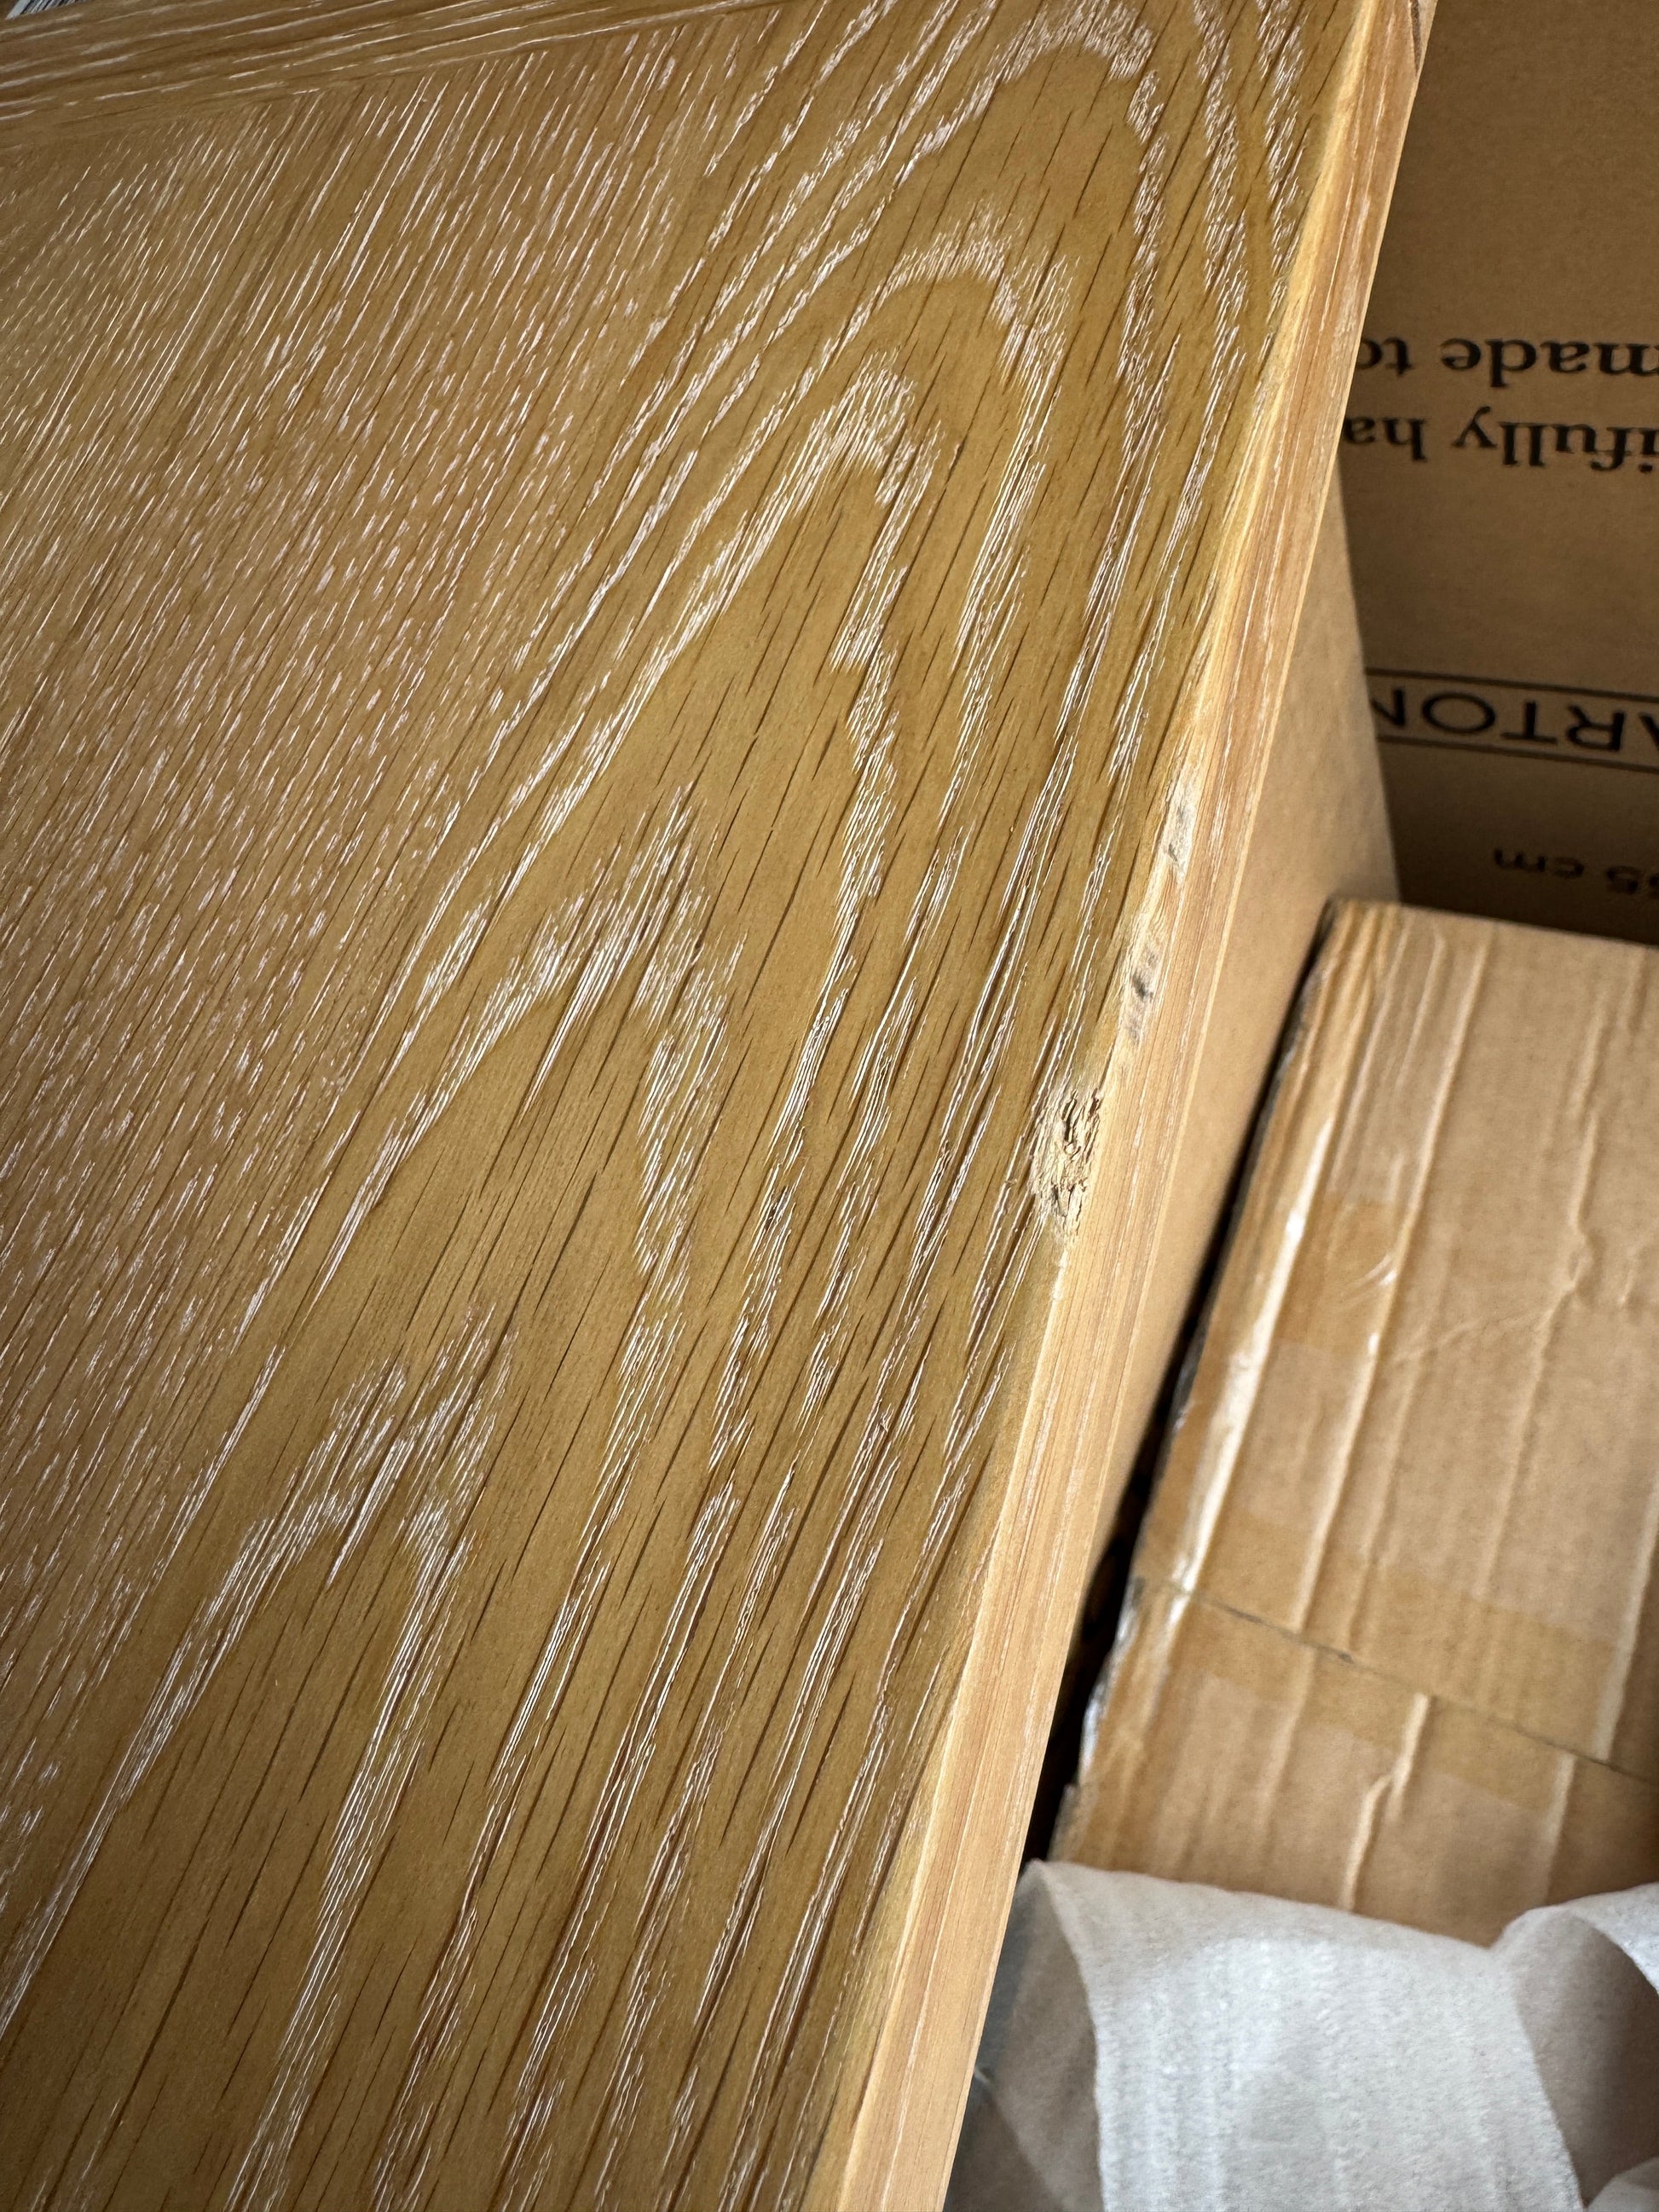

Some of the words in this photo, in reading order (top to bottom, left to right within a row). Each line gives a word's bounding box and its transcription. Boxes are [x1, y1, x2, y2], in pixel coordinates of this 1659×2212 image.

[1441, 338, 1659, 388] made
[1493, 848, 1585, 881] cm
[1604, 865, 1659, 898] 5
